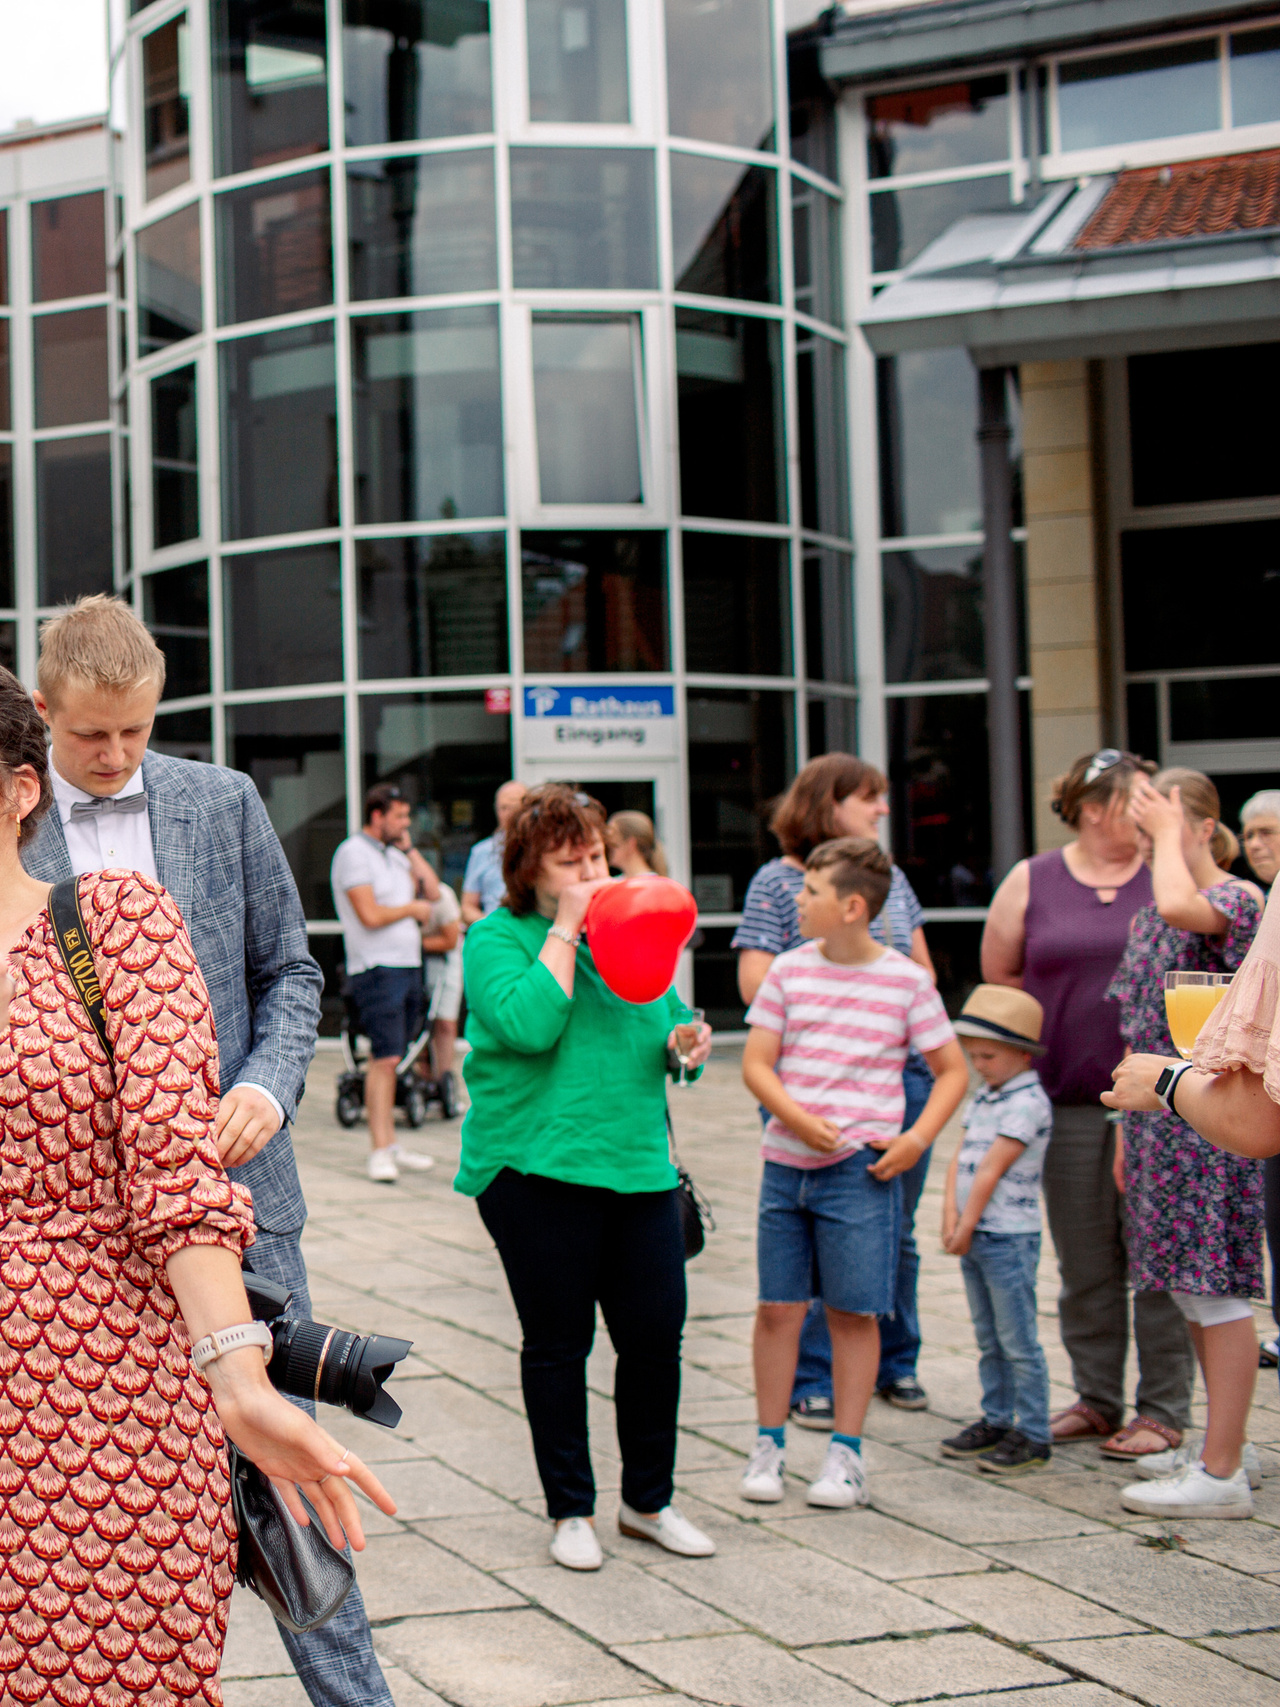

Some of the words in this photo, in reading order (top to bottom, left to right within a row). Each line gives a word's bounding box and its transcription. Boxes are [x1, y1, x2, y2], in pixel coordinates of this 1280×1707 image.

[570, 696, 662, 716] Rathaus
[556, 726, 644, 744] Eingang
[65, 929, 79, 950] FX
[69, 949, 102, 1007] D700
